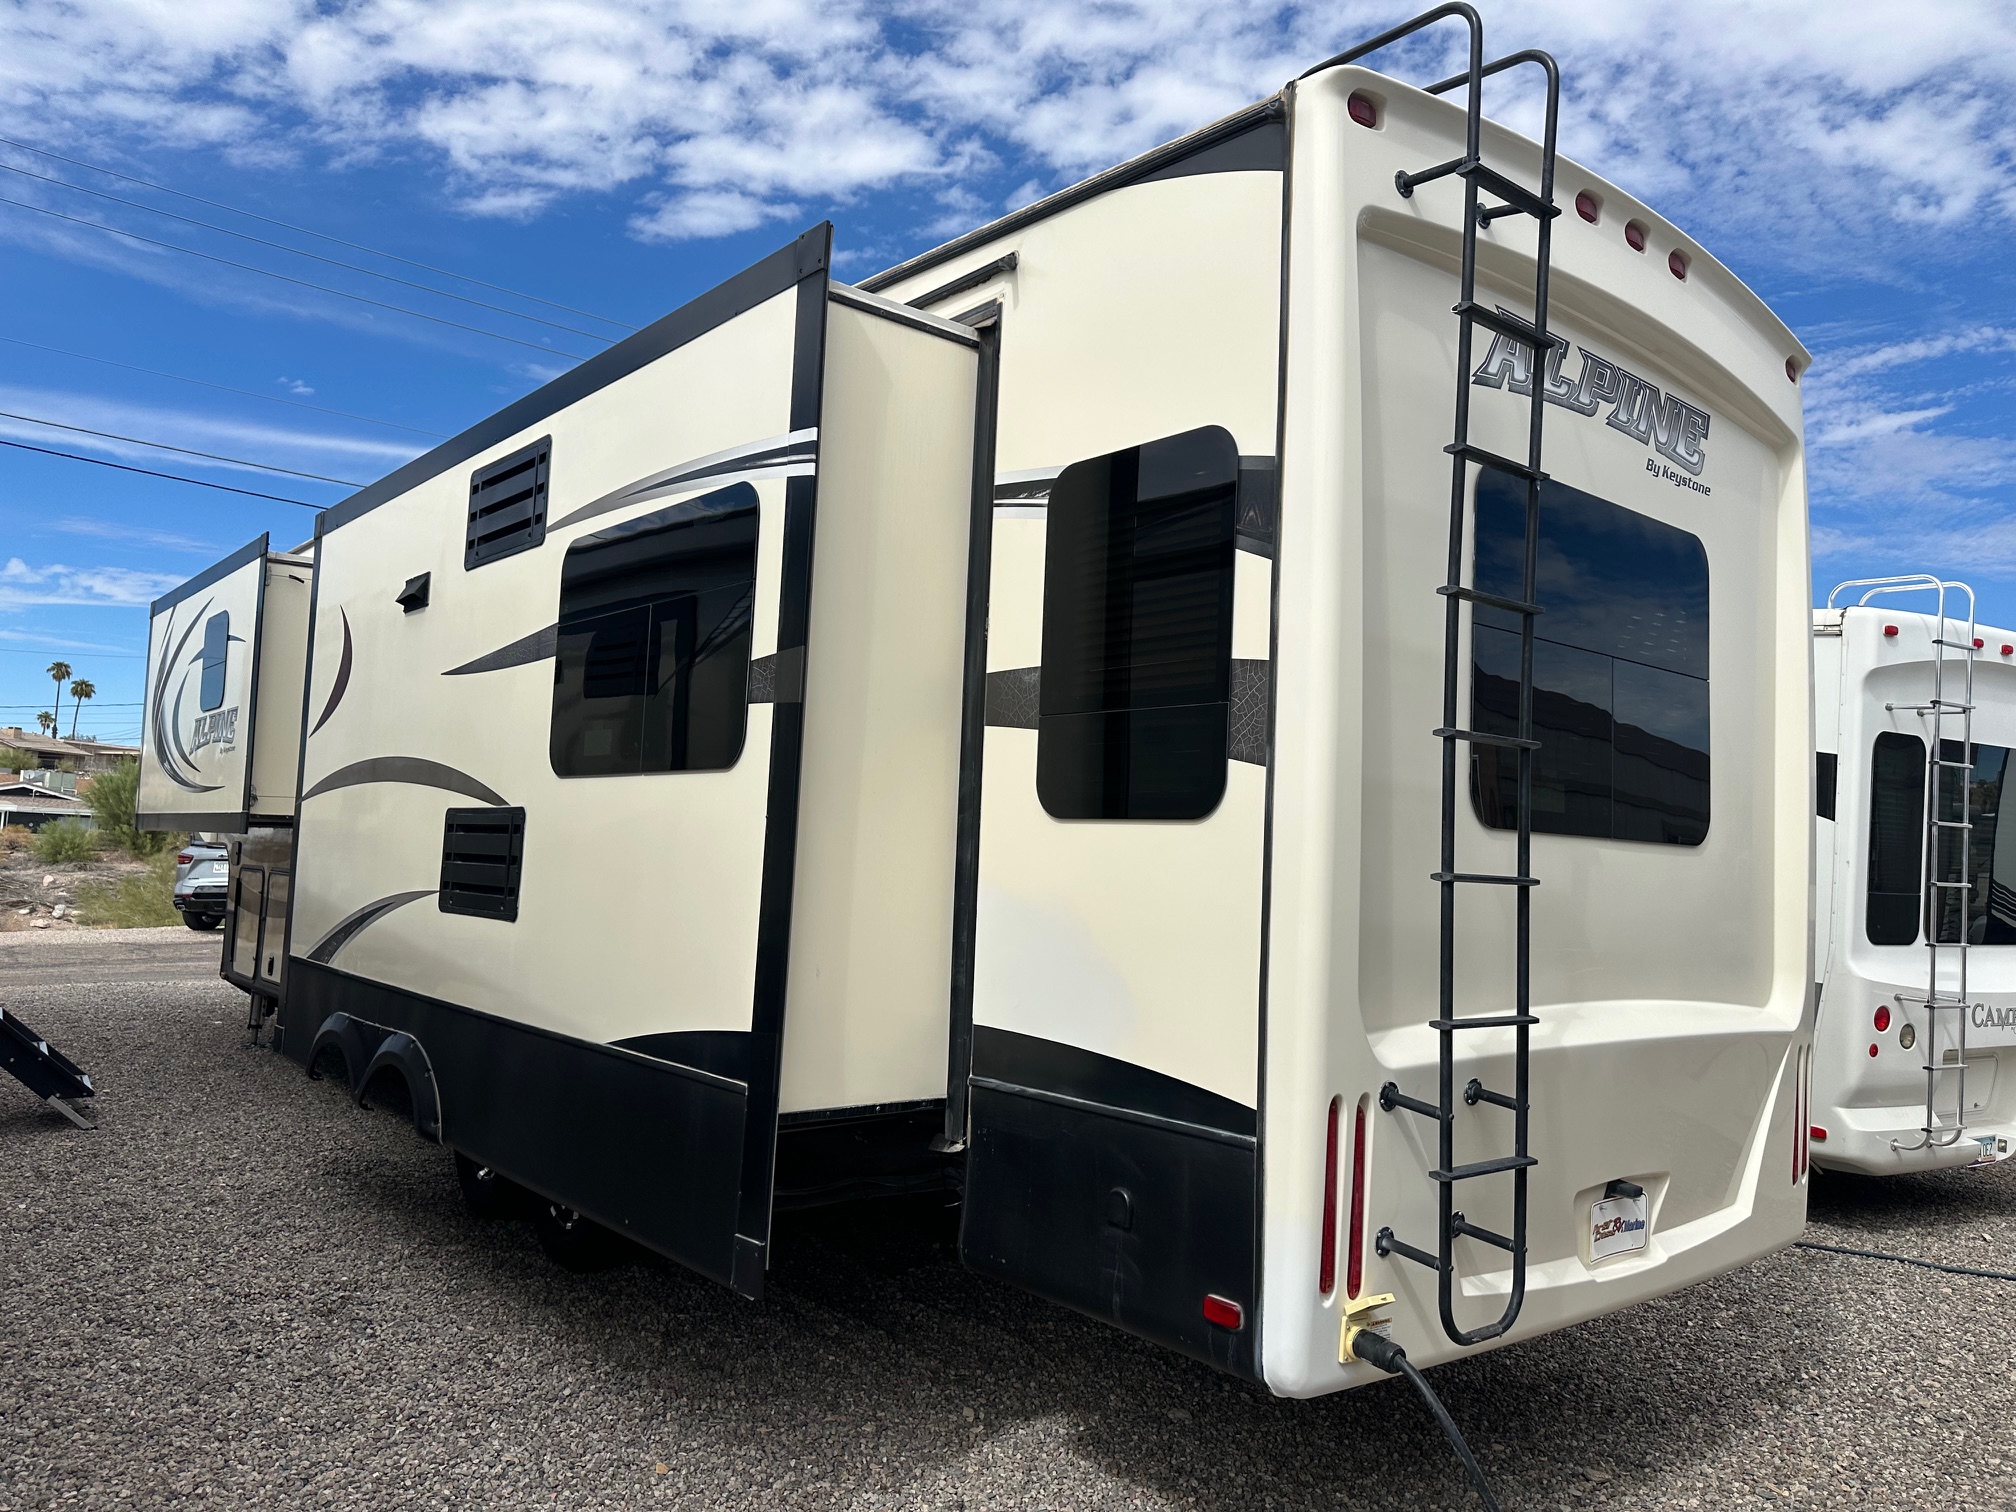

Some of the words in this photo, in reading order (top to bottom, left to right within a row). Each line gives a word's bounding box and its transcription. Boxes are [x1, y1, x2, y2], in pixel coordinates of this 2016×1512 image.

[1471, 304, 1711, 476] ALPINE
[1646, 457, 1661, 478] By
[1662, 464, 1711, 497] Keystone
[189, 705, 239, 757] ALPINE
